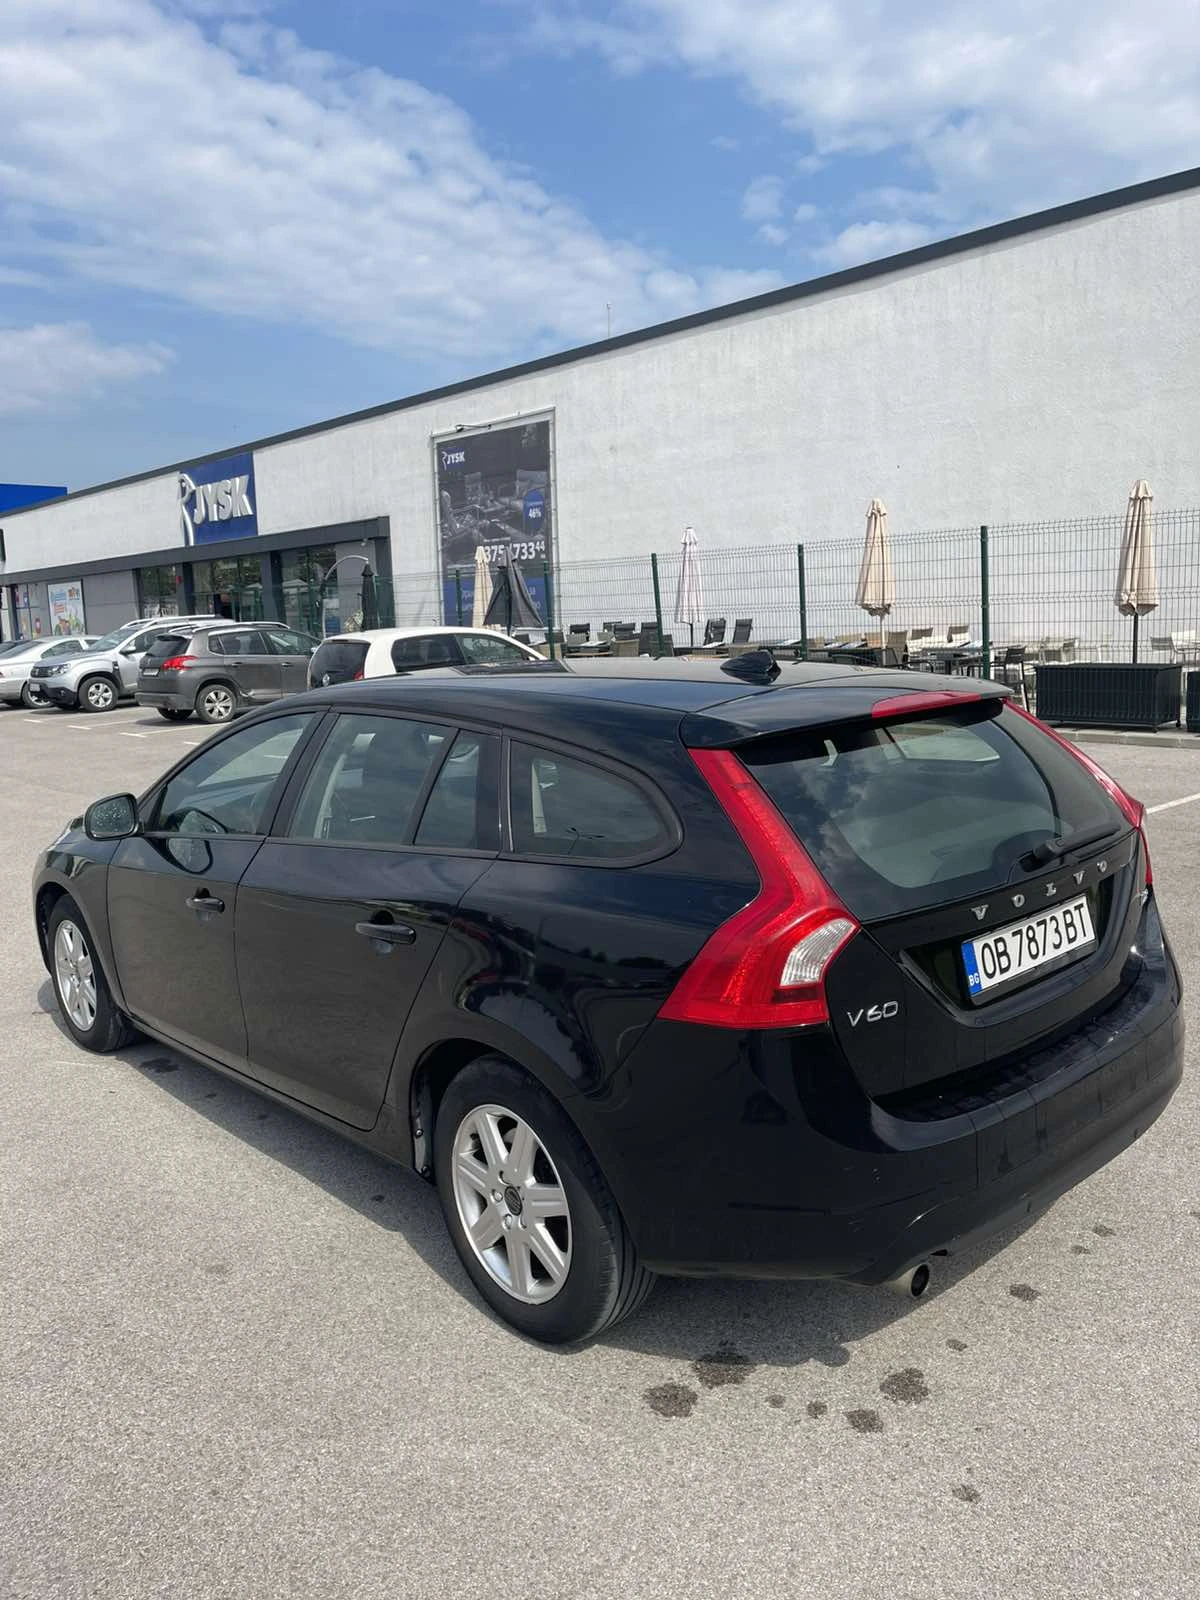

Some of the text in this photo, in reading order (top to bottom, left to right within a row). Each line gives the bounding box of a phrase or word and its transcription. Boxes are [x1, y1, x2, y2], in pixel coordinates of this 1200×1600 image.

[447, 451, 465, 464] JYSK
[193, 475, 253, 525] JYSK
[971, 860, 1107, 920] VOLVO
[968, 973, 980, 986] BG
[847, 1000, 898, 1027] V60
